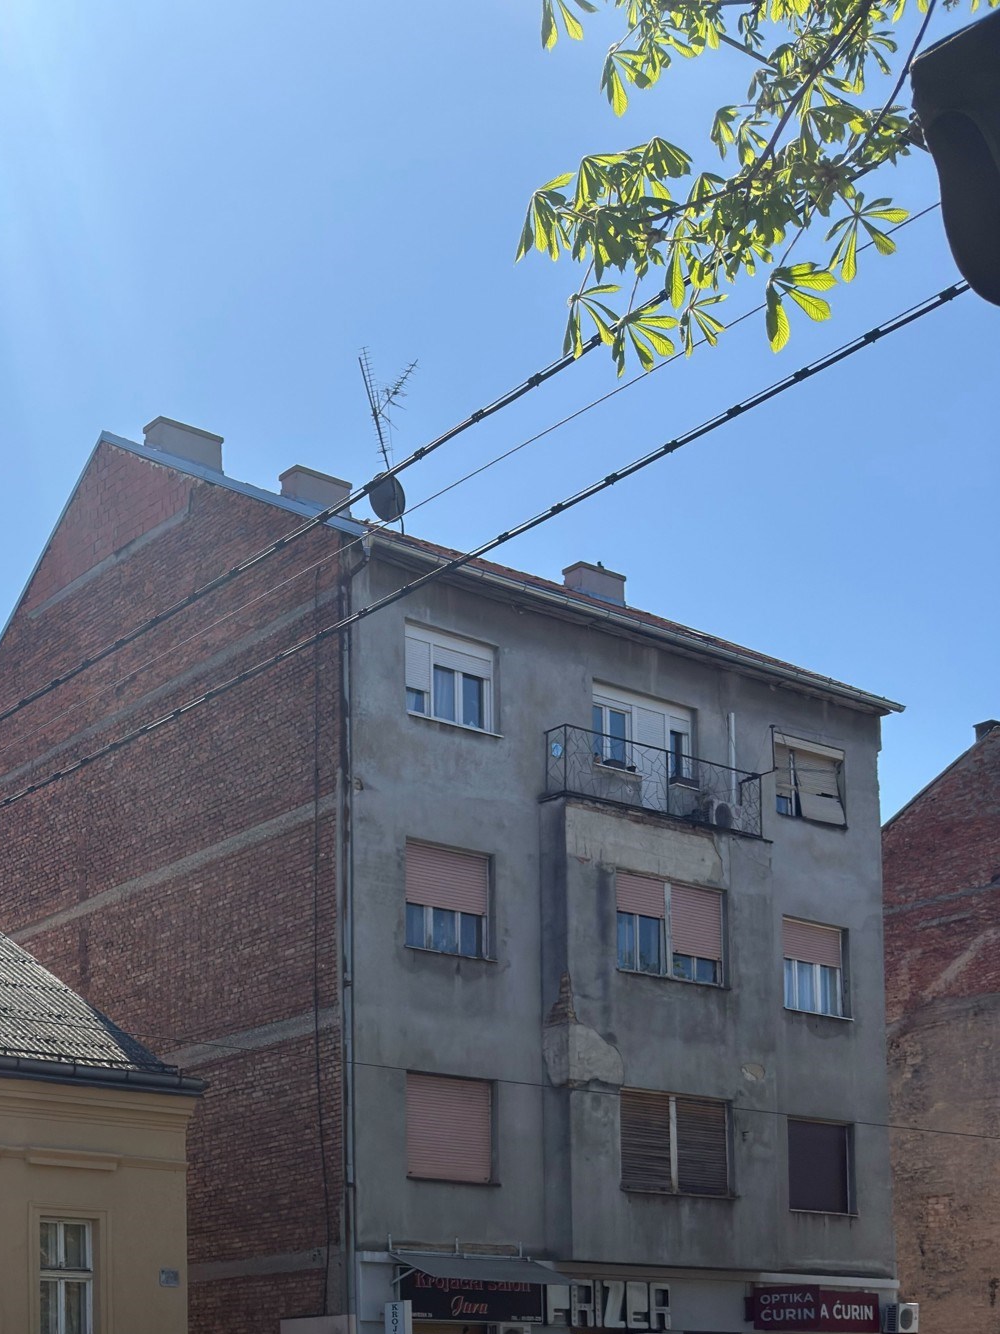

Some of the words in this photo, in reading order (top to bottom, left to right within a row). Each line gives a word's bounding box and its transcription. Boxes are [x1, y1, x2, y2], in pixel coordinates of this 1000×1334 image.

[760, 1292, 815, 1305] OPTIKA
[760, 1306, 815, 1322] ĆURIN
[832, 1300, 874, 1321] ĆURIN
